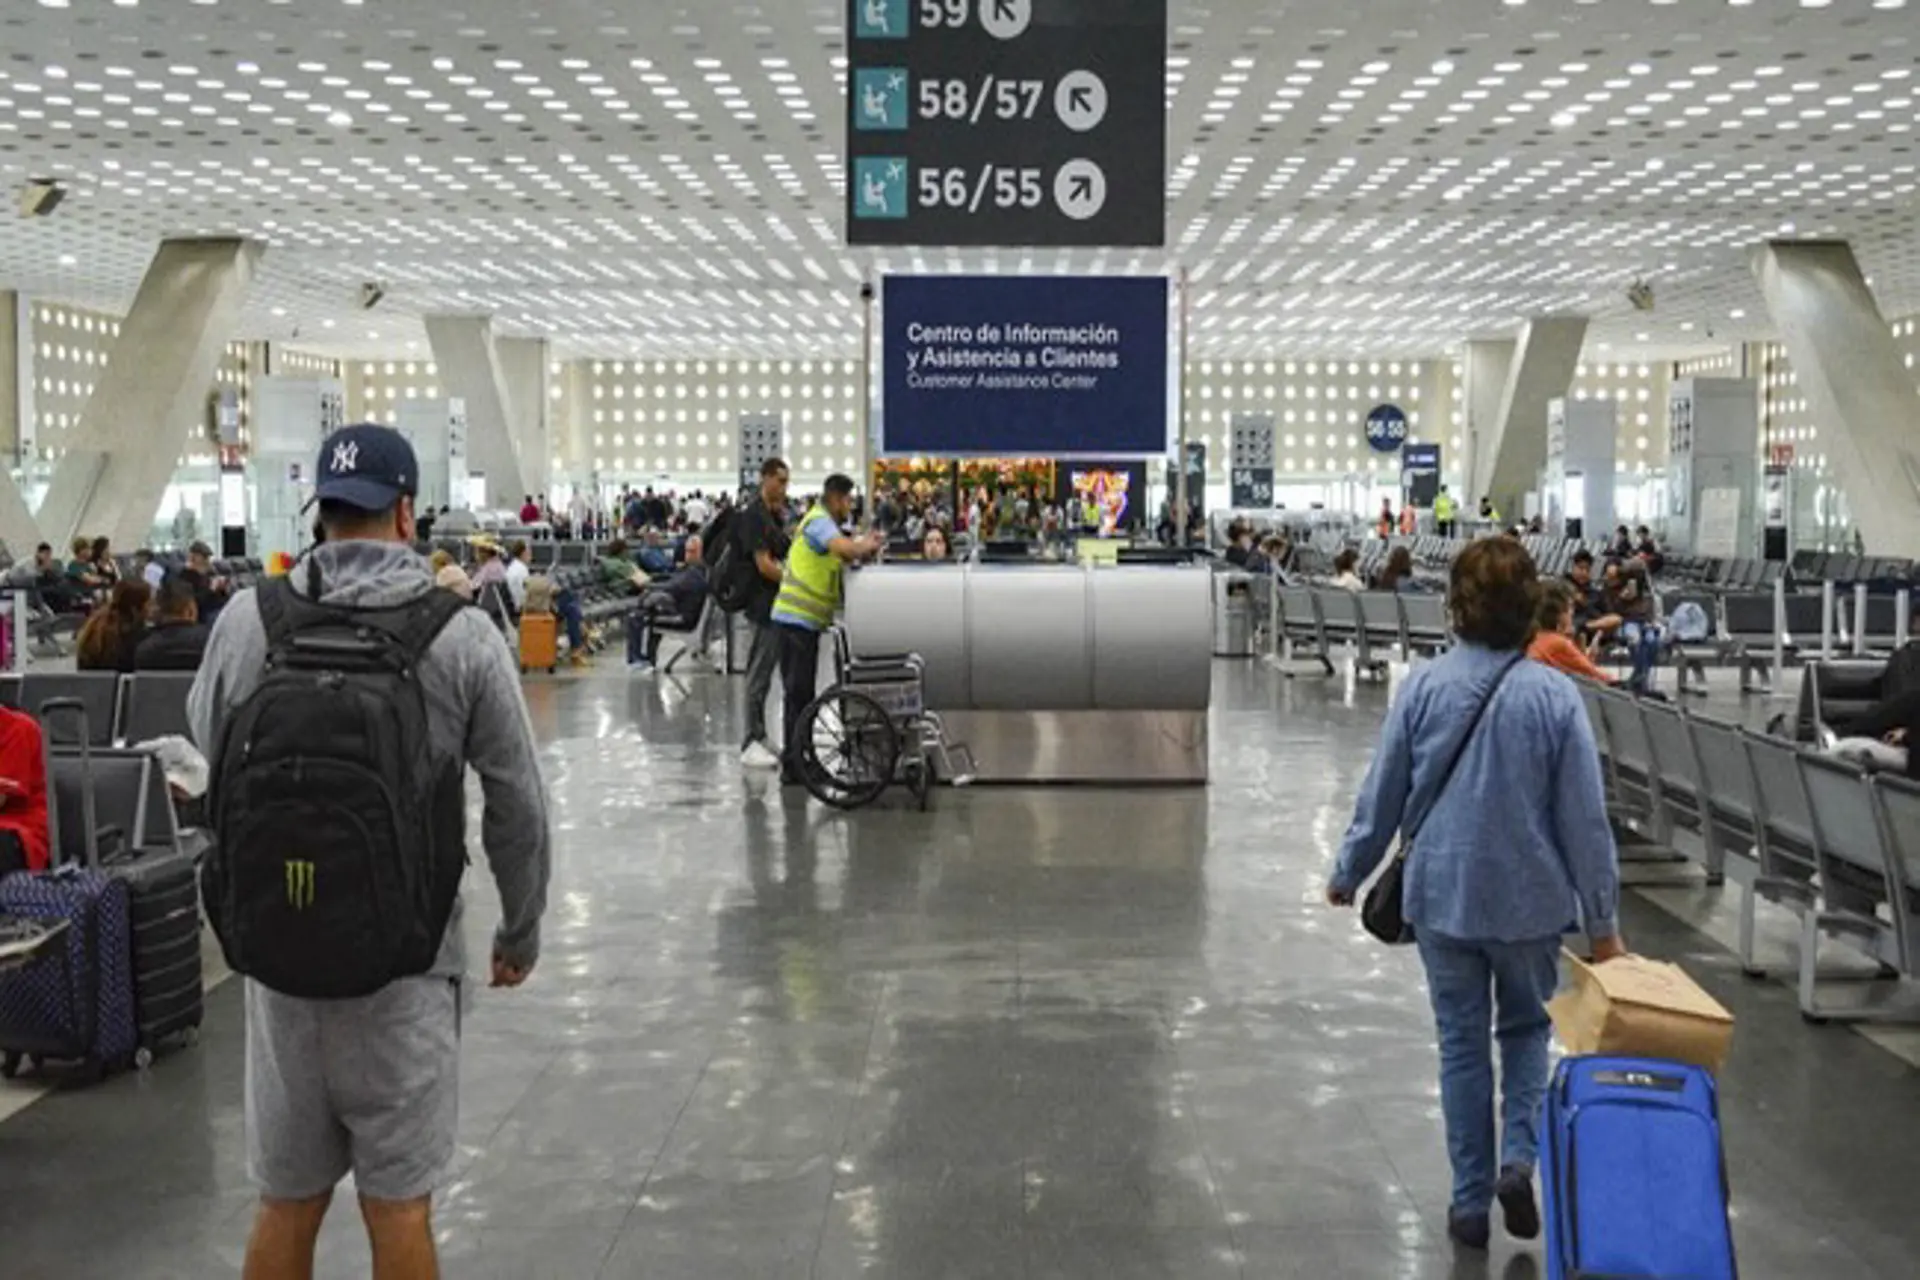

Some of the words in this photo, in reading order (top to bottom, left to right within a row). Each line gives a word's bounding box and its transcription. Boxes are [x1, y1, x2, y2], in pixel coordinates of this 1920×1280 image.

[920, 0, 969, 28] 59
[918, 74, 1044, 124] 58/57
[917, 163, 1043, 213] 56/55
[906, 322, 973, 344] Centro
[976, 322, 1001, 344] de
[1004, 322, 1119, 344] Información
[906, 351, 919, 371] y
[922, 346, 1021, 368] Asistencia
[1024, 351, 1037, 368] a
[1041, 346, 1119, 368] Clientes
[906, 371, 973, 389] Customer
[976, 371, 1050, 389] Assistance
[1051, 371, 1098, 389] Center
